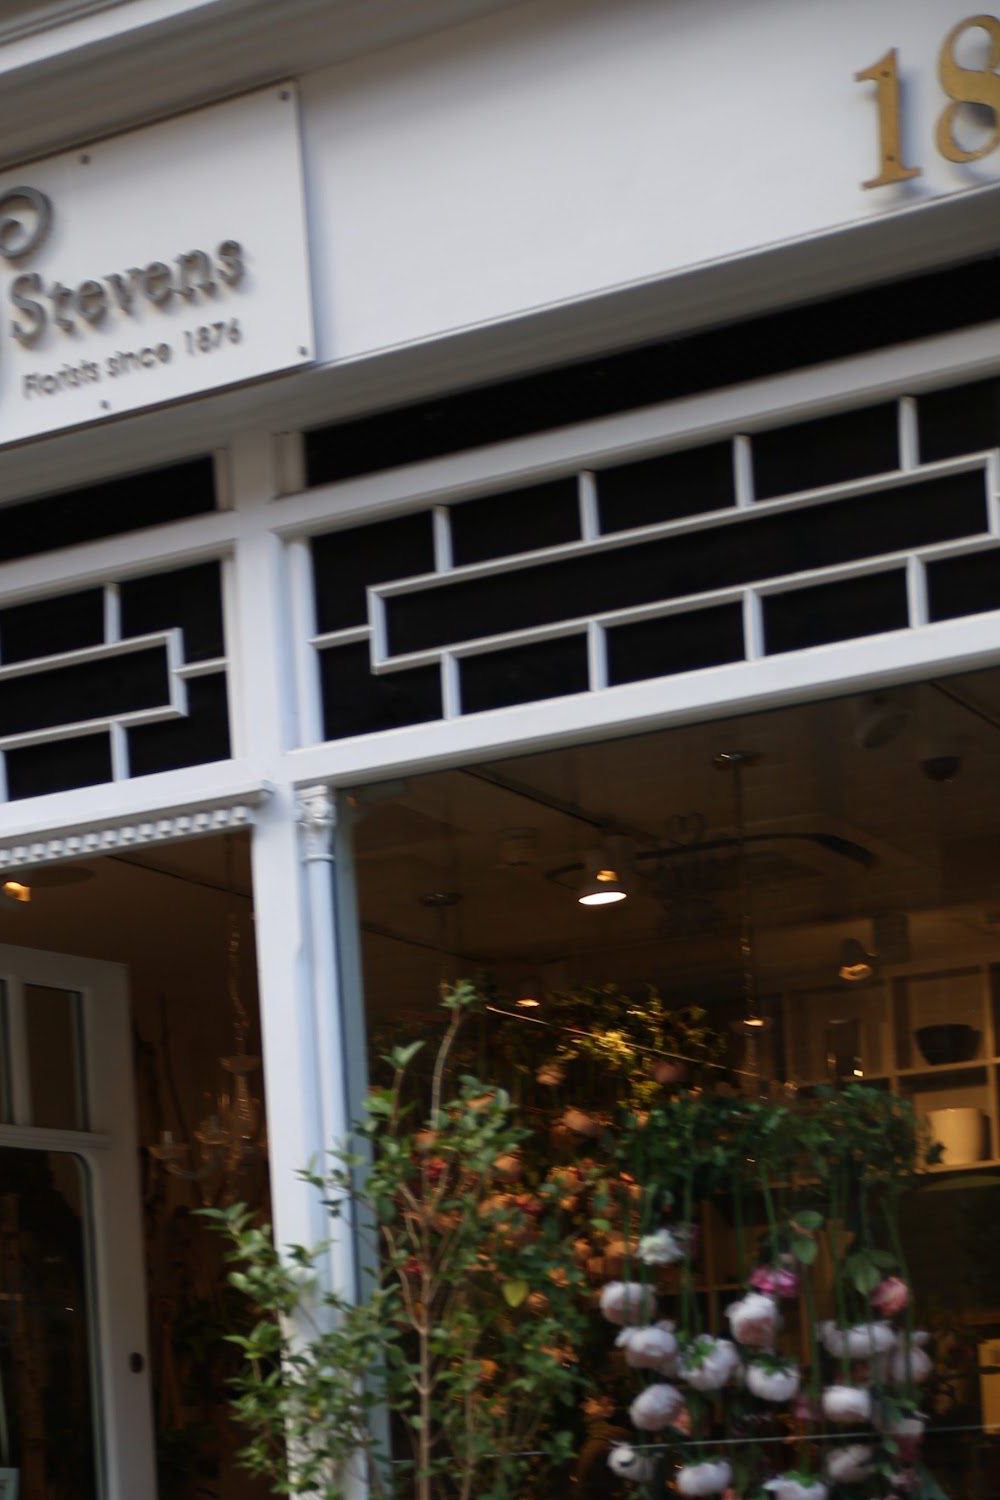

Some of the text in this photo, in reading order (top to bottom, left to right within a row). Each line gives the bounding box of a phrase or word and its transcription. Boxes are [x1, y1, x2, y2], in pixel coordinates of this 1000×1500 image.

[854, 14, 1000, 190] 18
[10, 239, 246, 349] Stevens
[22, 316, 243, 398] Florists since 1876
